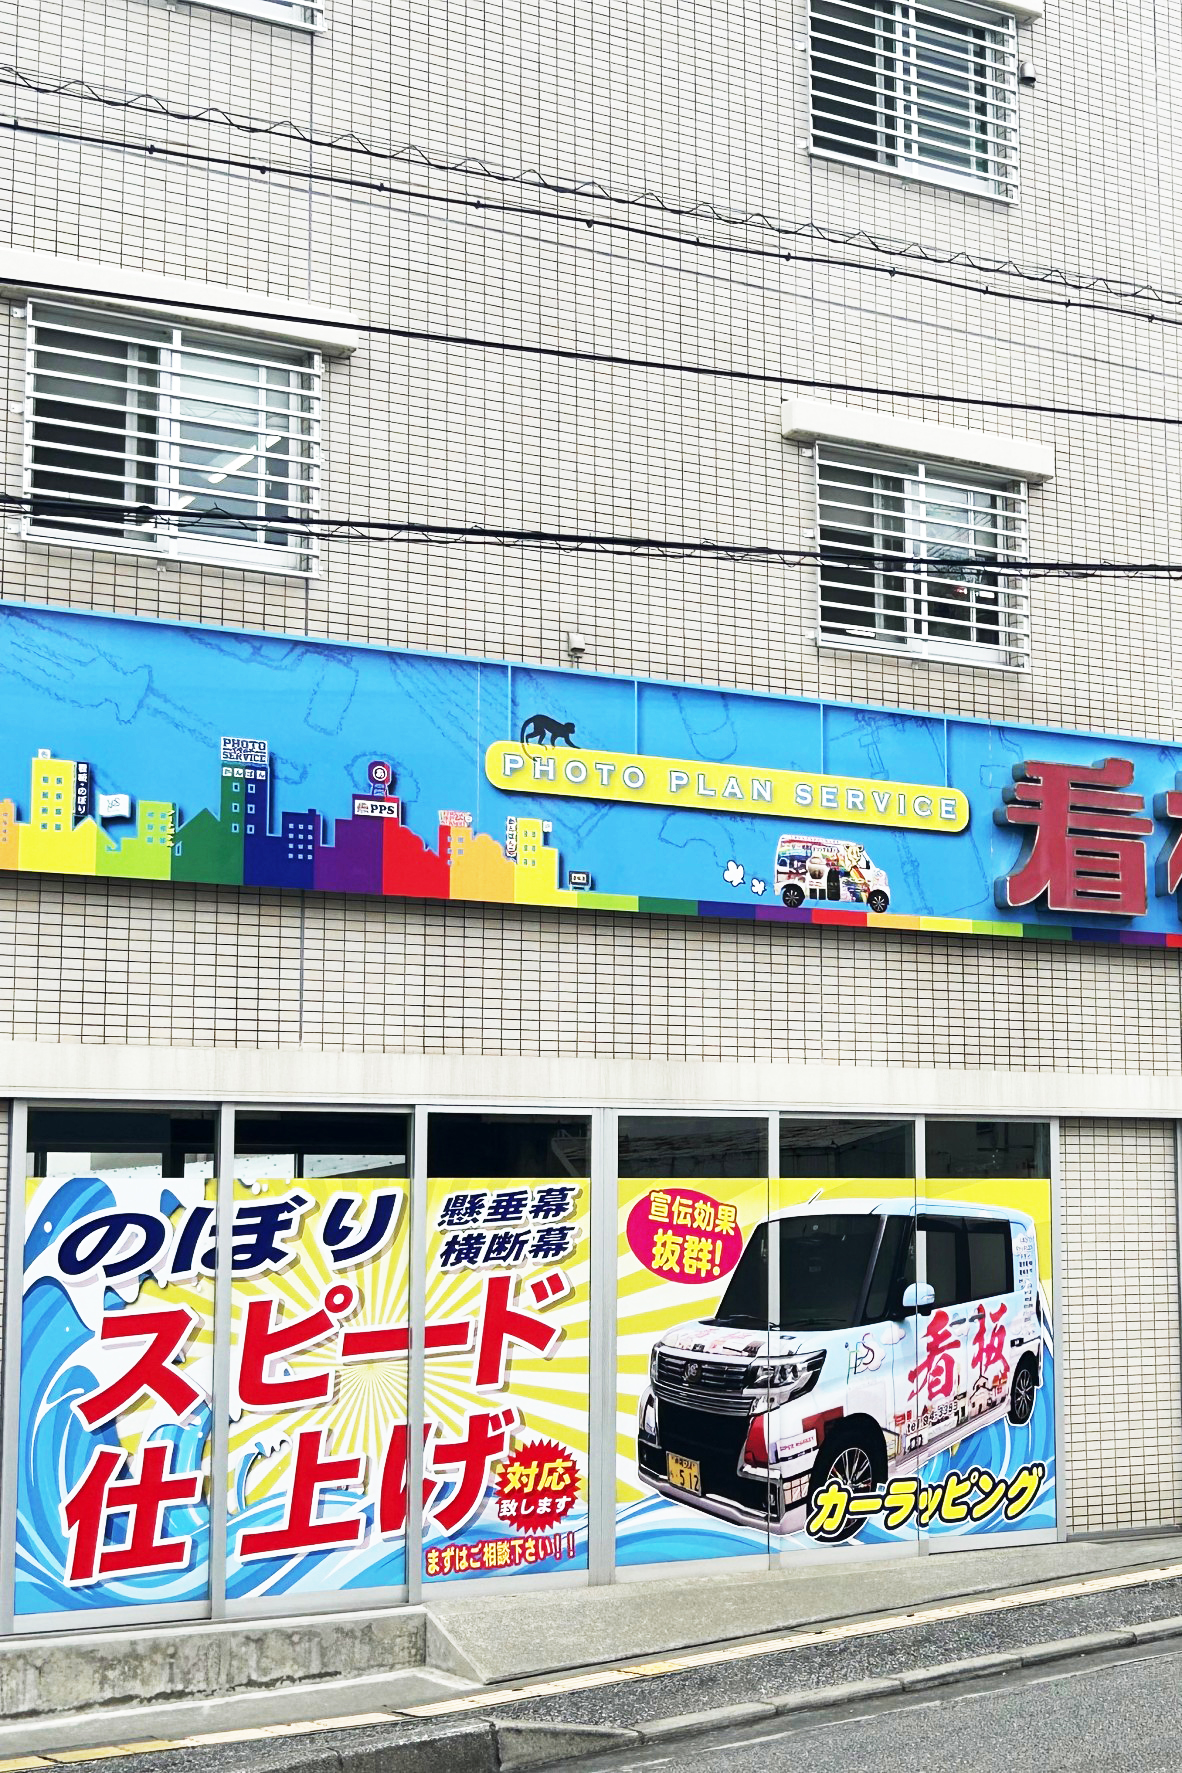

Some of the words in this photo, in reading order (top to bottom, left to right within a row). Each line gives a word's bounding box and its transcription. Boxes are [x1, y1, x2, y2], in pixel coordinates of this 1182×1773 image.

[222, 751, 266, 762] SERVICE
[223, 738, 266, 750] PHOTO
[370, 803, 395, 815] PPS
[502, 753, 646, 789] PHOTO
[670, 770, 772, 802] PLAN
[795, 782, 957, 820] SERVICE
[438, 1187, 576, 1227] 懸垂幕
[648, 1191, 736, 1236] 宣伝効果
[57, 1194, 398, 1277] のぼり
[440, 1226, 576, 1268] 横断幕
[651, 1228, 723, 1278] 抜群!
[77, 1274, 566, 1426] スピード
[907, 1302, 1011, 1402] 看板
[64, 1409, 514, 1582] 仕上げ
[503, 1458, 573, 1494] 対応
[809, 1463, 1044, 1534] カーラッピング
[498, 1495, 572, 1517] 致します
